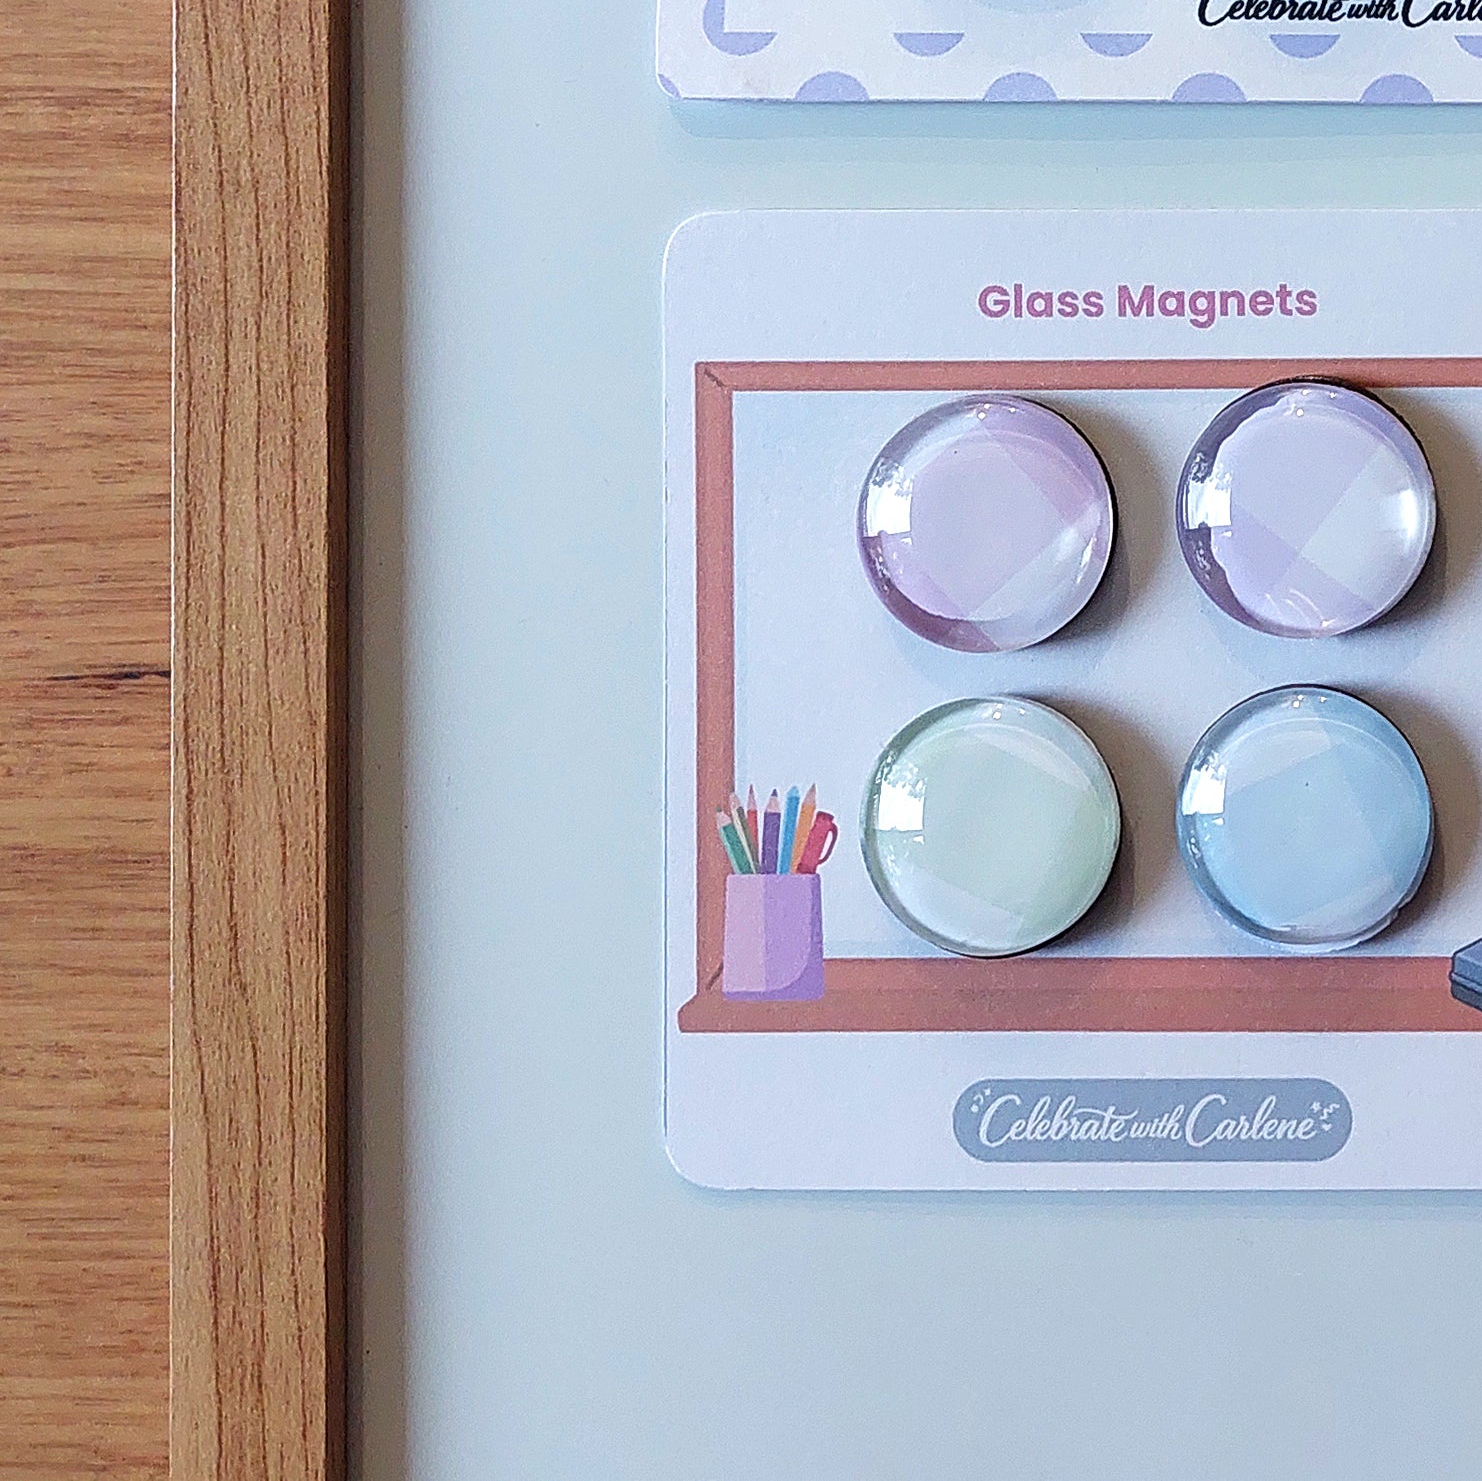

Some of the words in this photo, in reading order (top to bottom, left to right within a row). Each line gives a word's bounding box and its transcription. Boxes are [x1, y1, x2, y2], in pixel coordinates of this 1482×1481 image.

[978, 283, 1104, 318] Glass
[1117, 283, 1317, 329] Magnets
[979, 1094, 1139, 1147] Celebrate
[1130, 1104, 1184, 1140] with
[1185, 1093, 1317, 1147] Carlene
